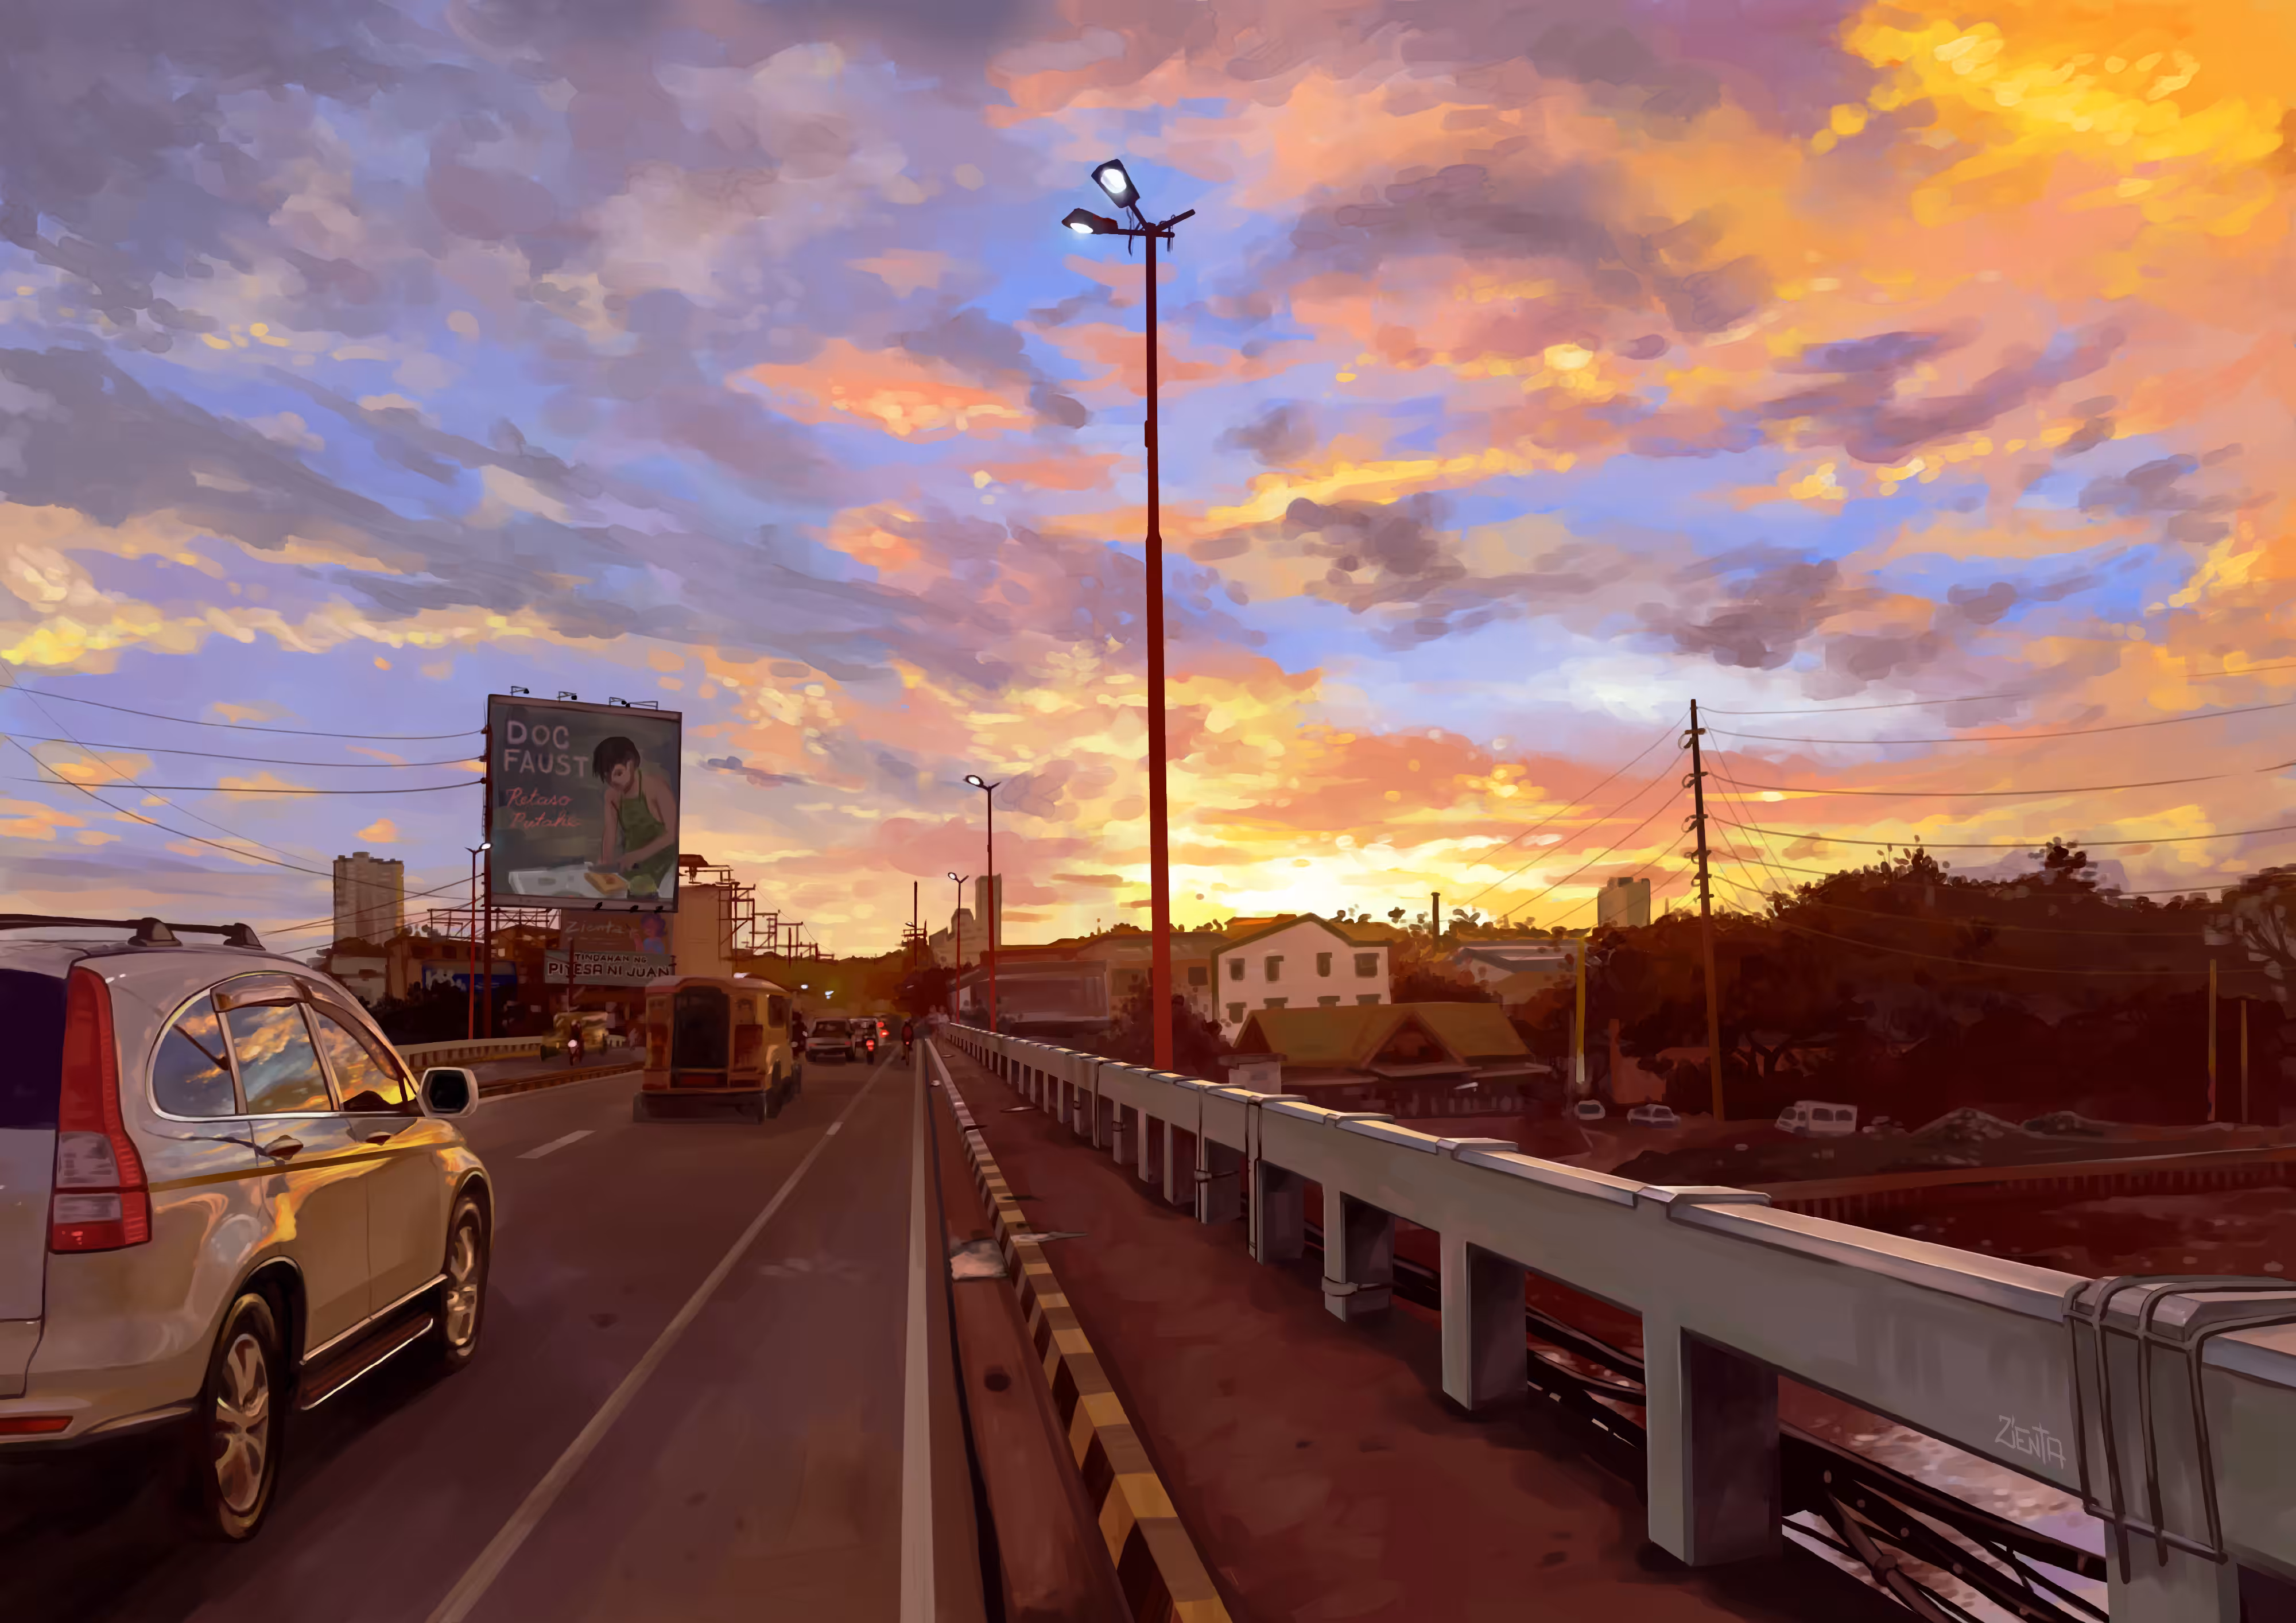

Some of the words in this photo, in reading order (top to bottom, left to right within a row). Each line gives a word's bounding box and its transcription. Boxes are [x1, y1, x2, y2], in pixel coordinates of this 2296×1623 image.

[507, 720, 570, 750] DOC
[503, 748, 589, 777] FAUST
[506, 787, 573, 808] Retaso
[575, 953, 629, 962] TINDAHAN
[607, 965, 622, 975] NI
[627, 967, 669, 977] JUAN
